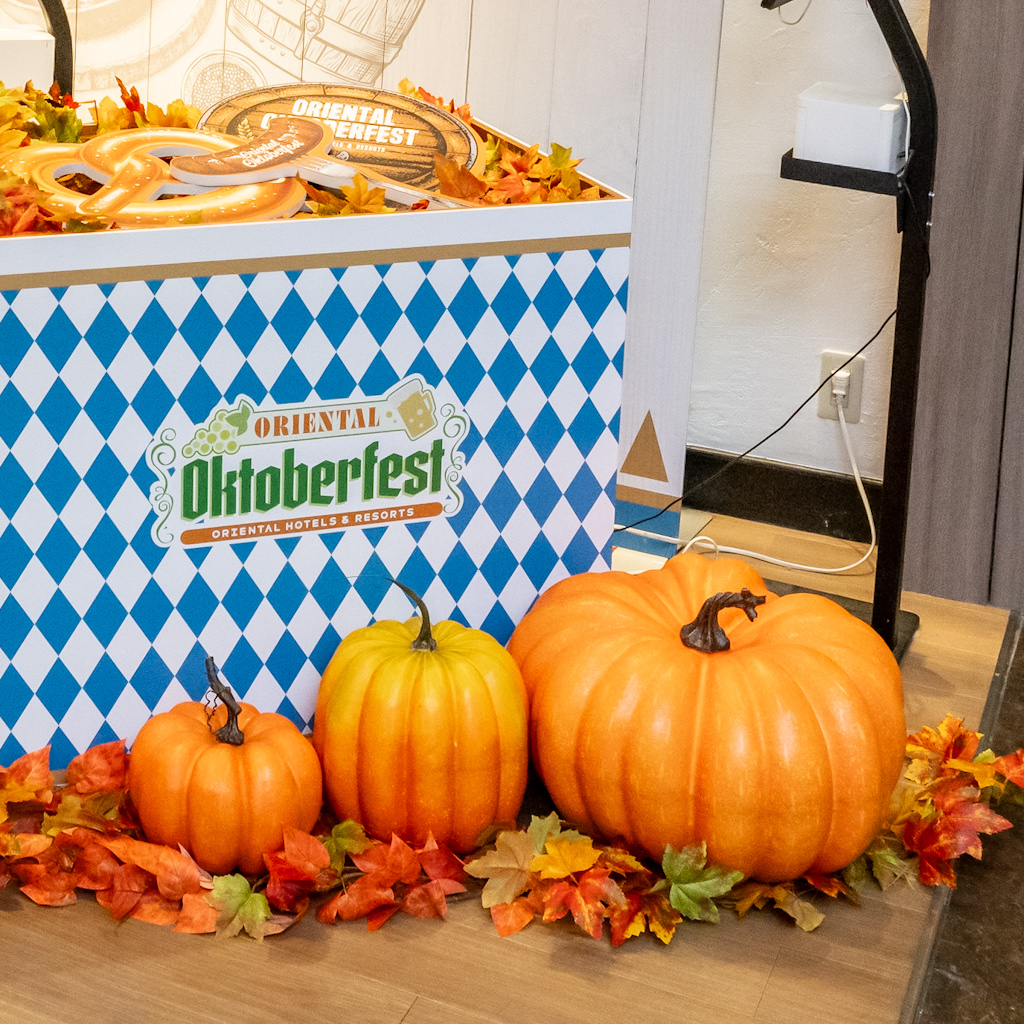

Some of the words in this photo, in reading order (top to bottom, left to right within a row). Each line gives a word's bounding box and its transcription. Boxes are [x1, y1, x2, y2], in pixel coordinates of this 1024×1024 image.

[291, 98, 395, 127] ORIENTAL
[242, 139, 305, 168] Oktoberfest
[254, 406, 381, 439] ORIENTAL
[180, 438, 446, 523] Oktoberfest
[211, 524, 281, 539] ORIENTAL
[285, 517, 337, 531] HOTELS
[341, 515, 349, 525] &
[355, 507, 415, 523] RESORTS
